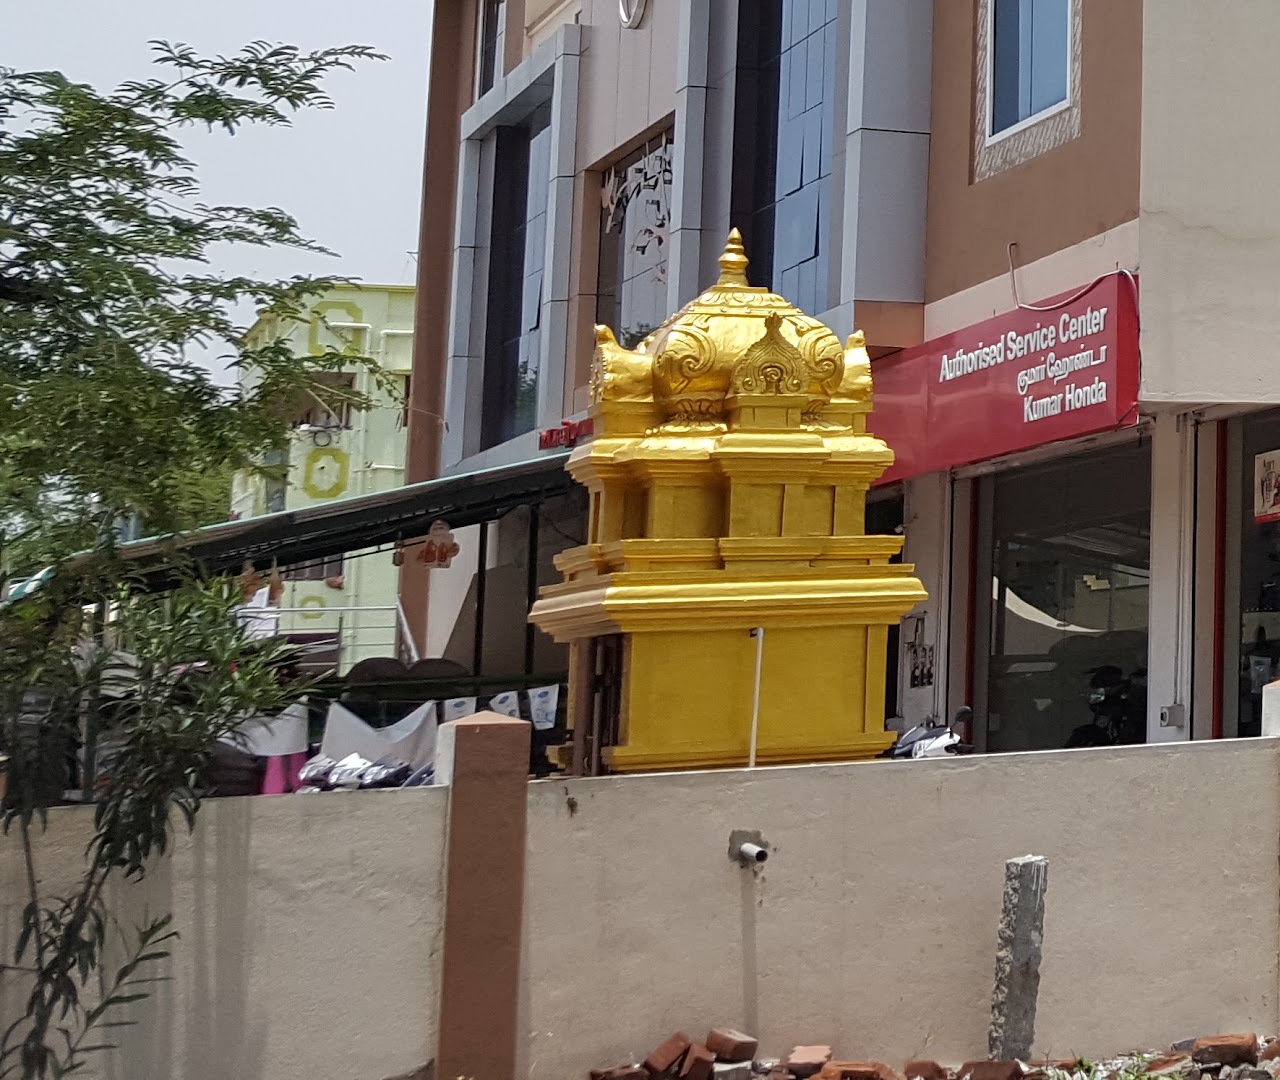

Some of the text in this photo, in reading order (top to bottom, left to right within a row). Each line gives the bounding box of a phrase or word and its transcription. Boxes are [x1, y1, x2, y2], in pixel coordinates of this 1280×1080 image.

[939, 306, 1108, 383] Authorised Service Center
[1017, 356, 1046, 396] குமார்
[1023, 376, 1107, 423] Kumar Honda
